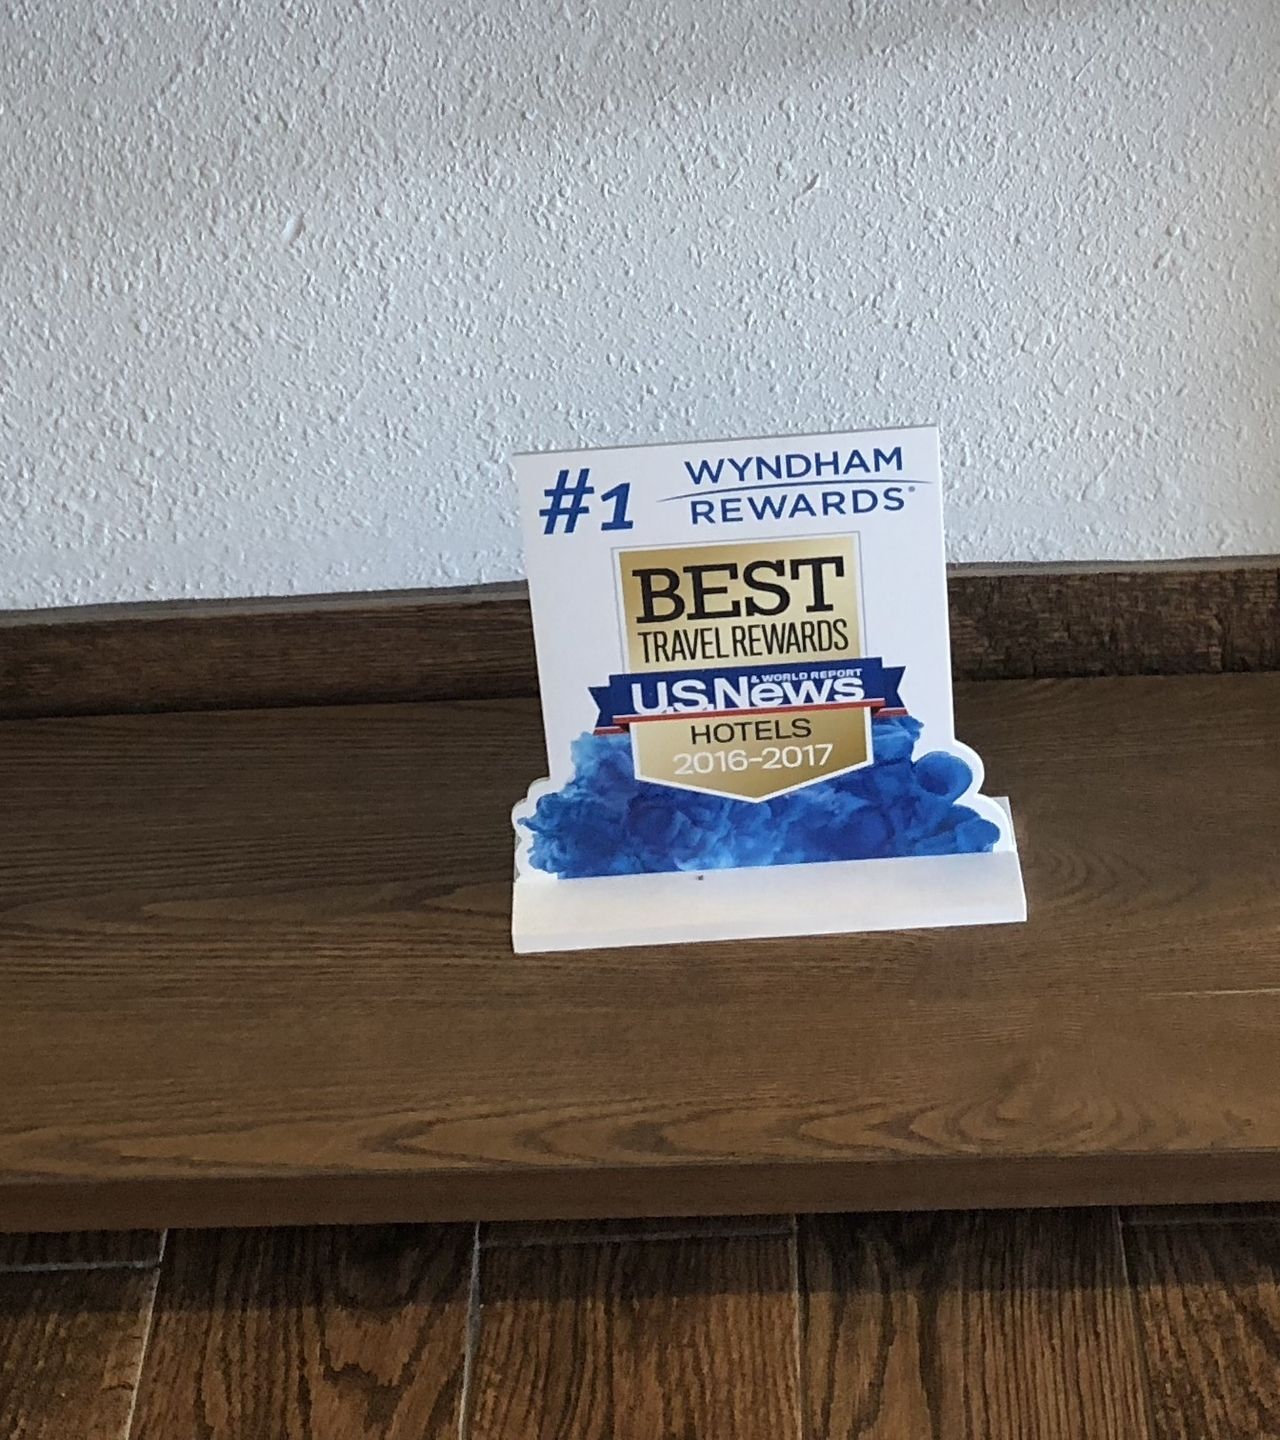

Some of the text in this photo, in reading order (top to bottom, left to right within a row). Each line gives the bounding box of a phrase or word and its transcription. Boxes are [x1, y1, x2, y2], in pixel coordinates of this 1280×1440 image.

[684, 446, 904, 485] WYNDHAM
[539, 467, 634, 535] #1
[690, 486, 906, 526] REWARDS
[631, 556, 845, 624] BEST
[638, 618, 849, 663] TRAVEL REWARDS
[750, 668, 863, 684] & WORLD REPORT
[691, 717, 813, 745] HOTELS
[673, 743, 834, 776] 2016-2017
